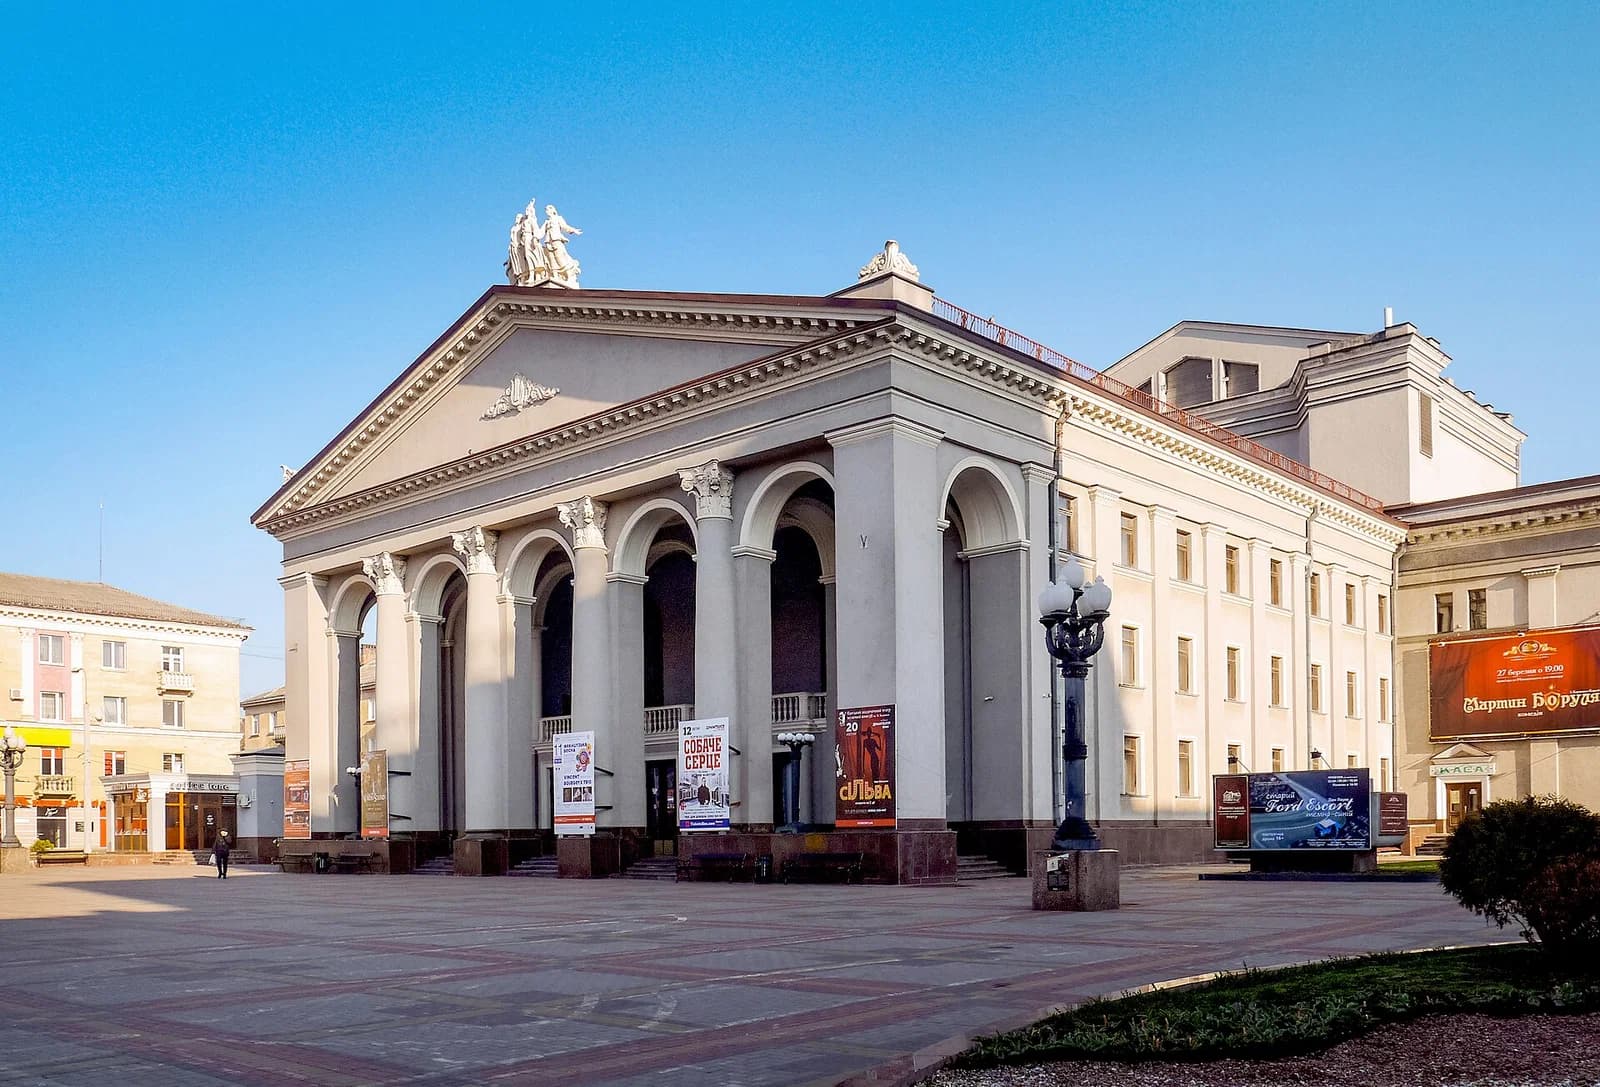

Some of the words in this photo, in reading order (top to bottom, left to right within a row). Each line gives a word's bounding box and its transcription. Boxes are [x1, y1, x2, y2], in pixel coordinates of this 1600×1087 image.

[1463, 697, 1527, 714] Мартин
[1532, 691, 1600, 711] Боруля
[683, 727, 692, 735] 12
[846, 722, 858, 732] 20
[684, 737, 722, 754] СОБАЧЕ
[685, 754, 721, 770] СЕРЦЕ
[1265, 799, 1304, 813] Ford
[1306, 797, 1354, 811] Escort
